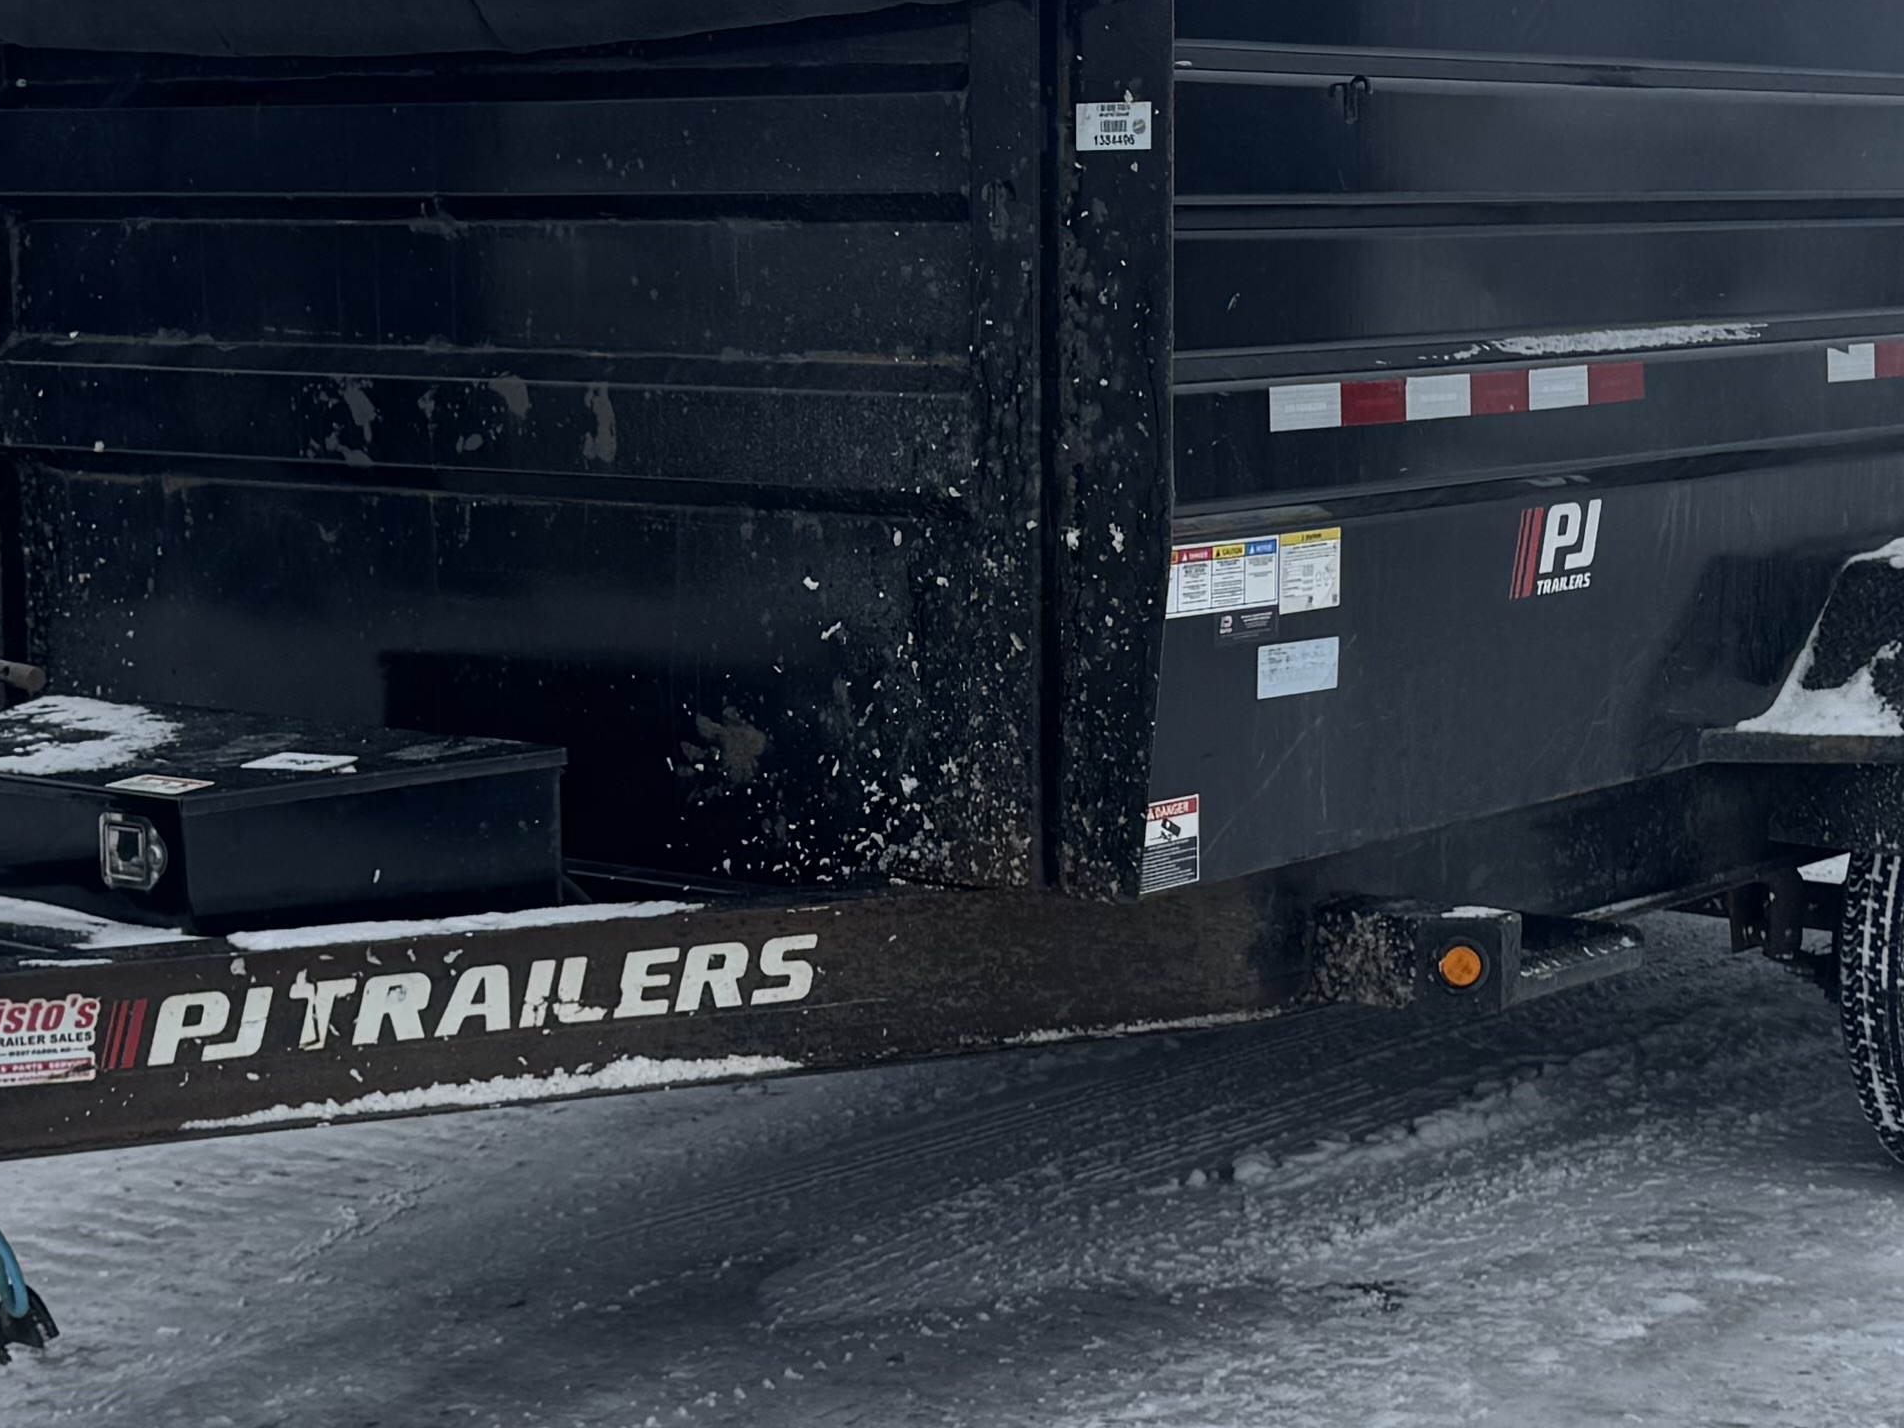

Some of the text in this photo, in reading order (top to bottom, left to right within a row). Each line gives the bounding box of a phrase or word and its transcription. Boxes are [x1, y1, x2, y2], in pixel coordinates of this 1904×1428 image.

[1538, 498, 1602, 574] PJ
[1536, 572, 1592, 596] TRAILERS
[147, 932, 819, 1067] PJ TRAILERS
[50, 1031, 93, 1044] SALES
